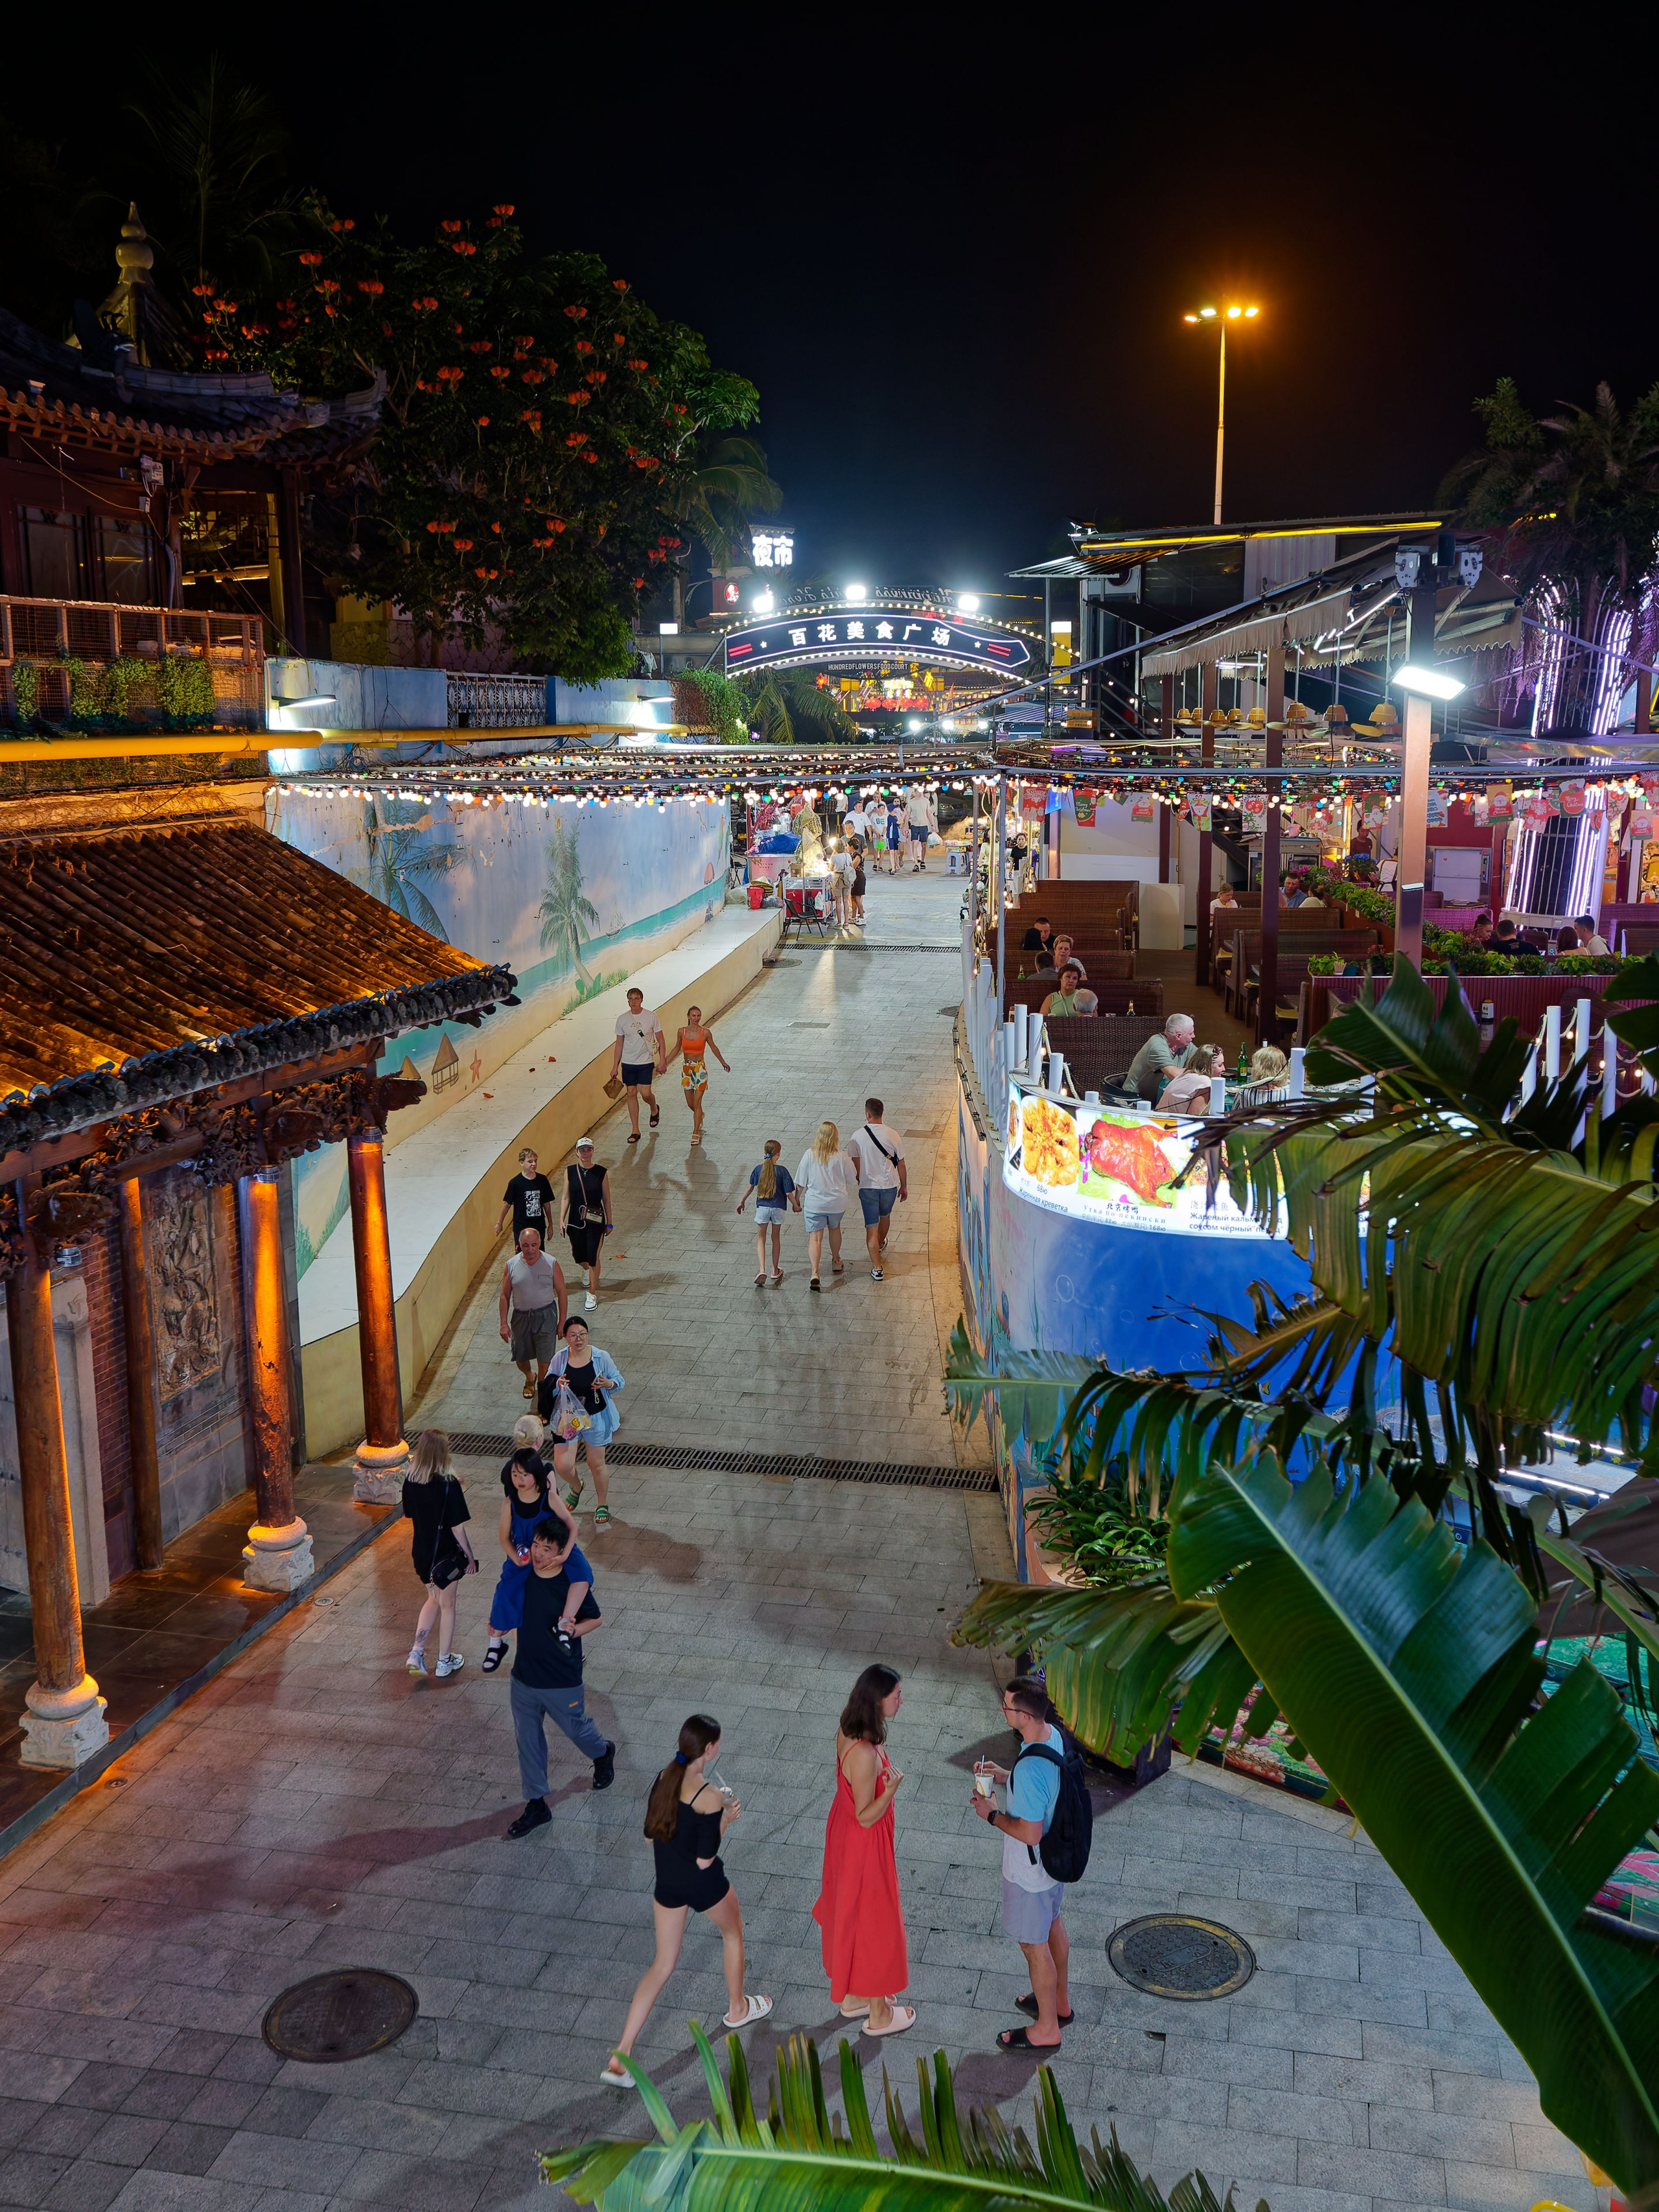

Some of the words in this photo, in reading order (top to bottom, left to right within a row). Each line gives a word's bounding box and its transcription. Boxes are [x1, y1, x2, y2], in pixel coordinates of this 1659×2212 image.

[752, 534, 794, 567] 夜市
[788, 620, 951, 646] 百花美食广场
[1041, 1199, 1068, 1213] креветка
[1231, 1215, 1264, 1224] кальм
